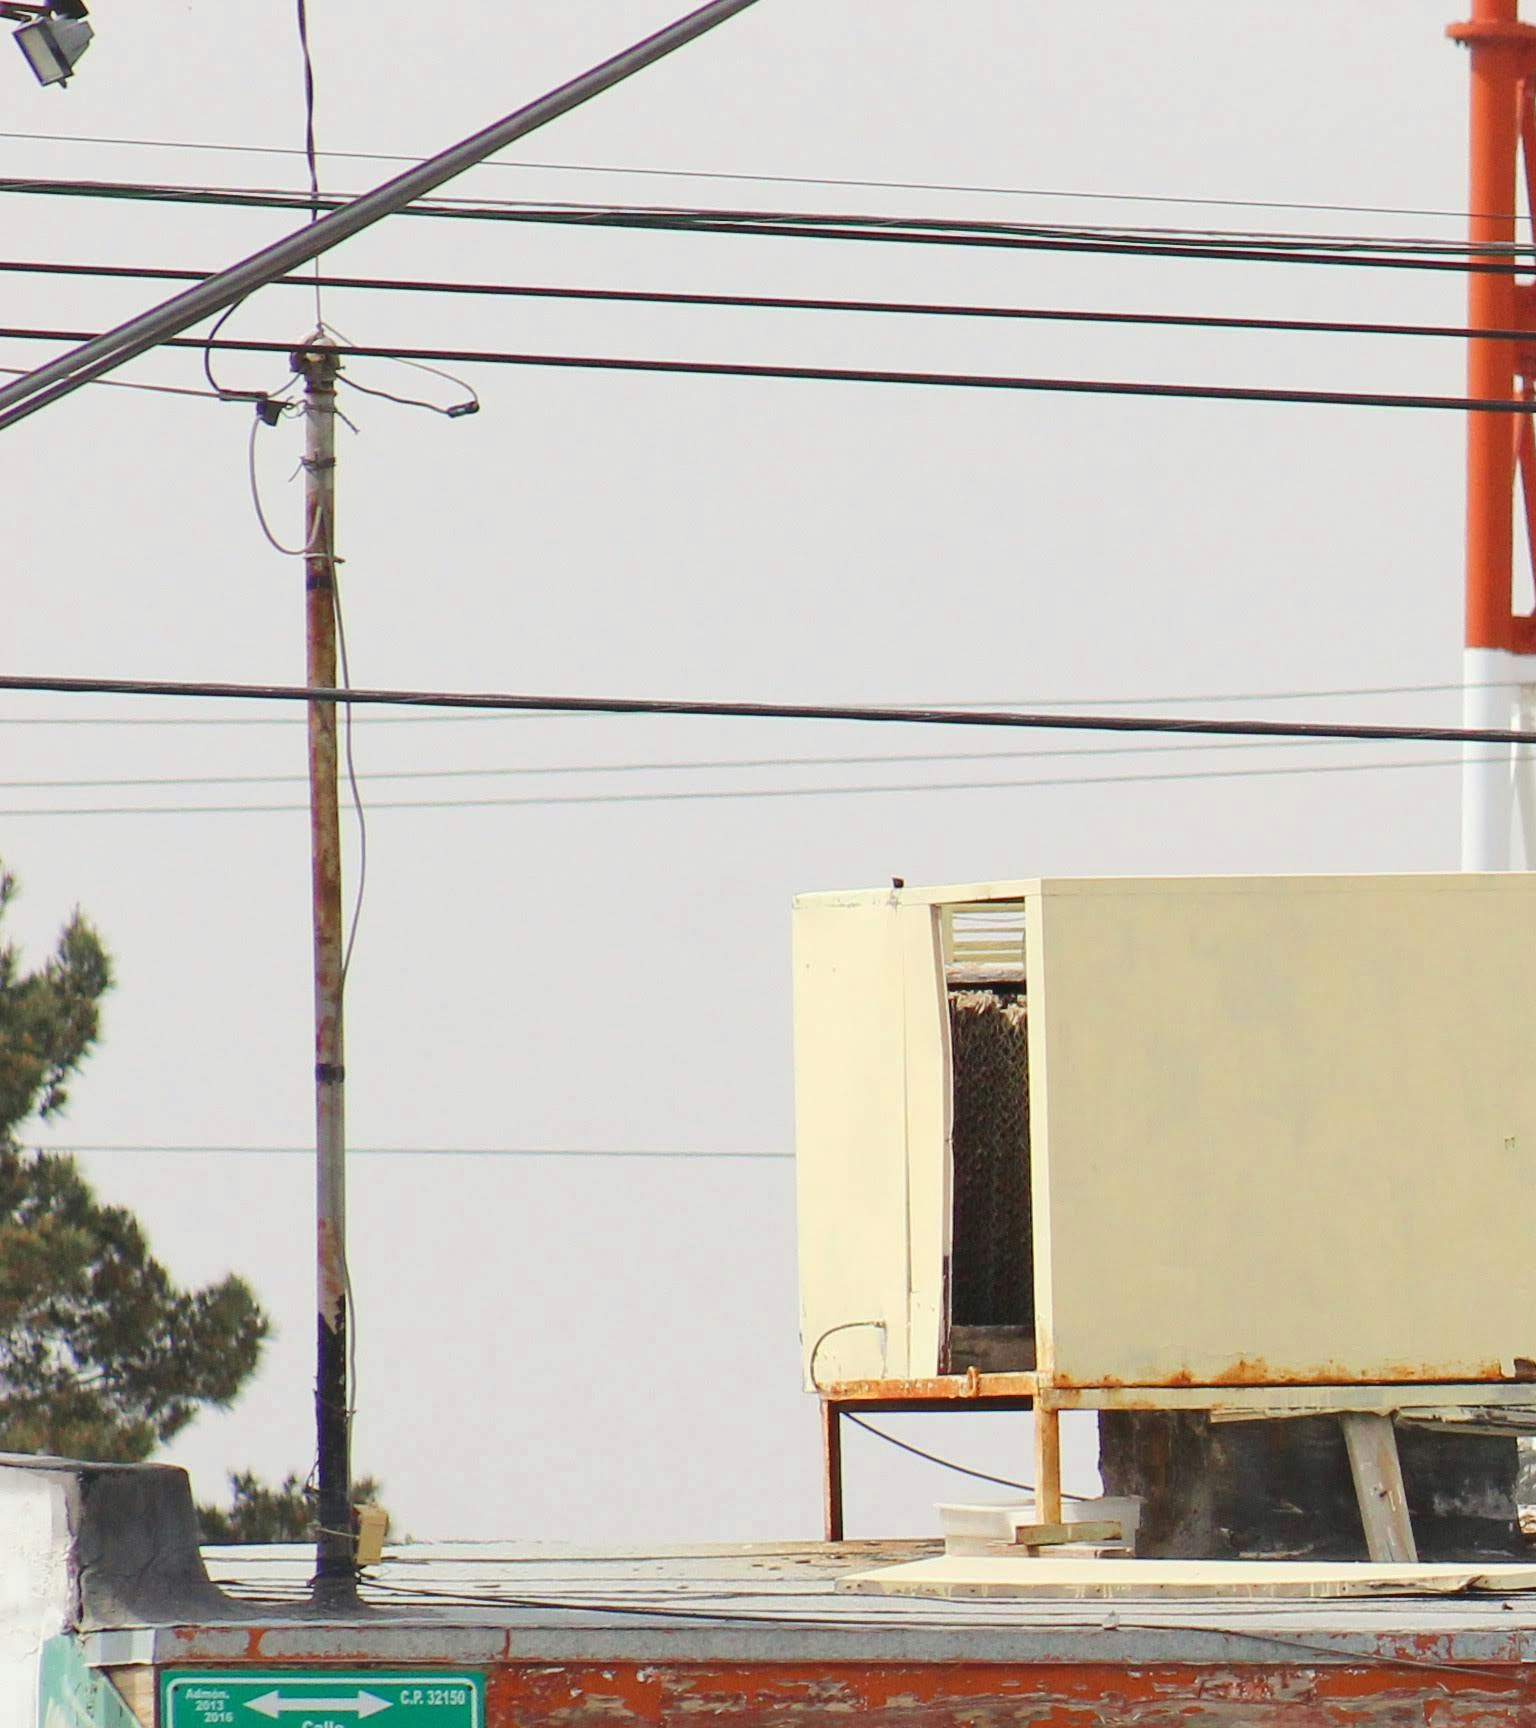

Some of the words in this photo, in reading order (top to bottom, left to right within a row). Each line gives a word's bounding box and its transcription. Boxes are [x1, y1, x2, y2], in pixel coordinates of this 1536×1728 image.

[401, 1690, 423, 1705] C.P.
[428, 1690, 466, 1705] 32150
[195, 1700, 224, 1711] 2013
